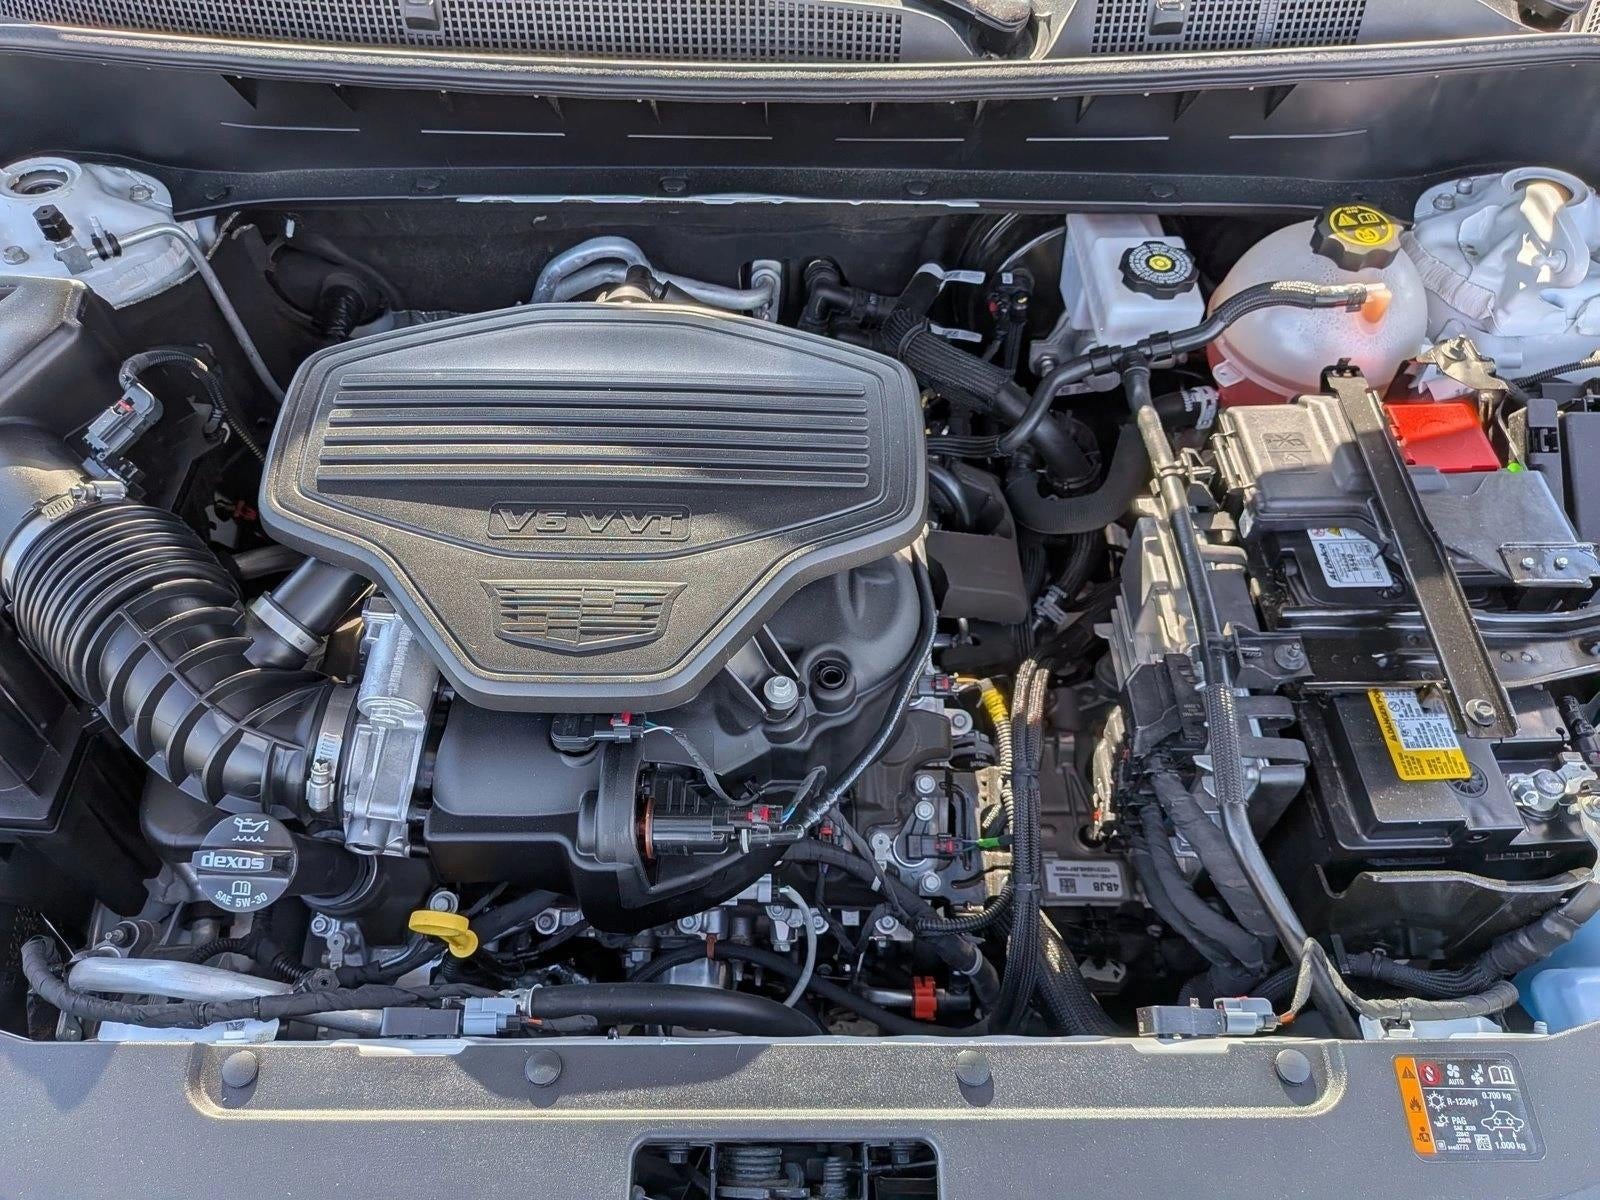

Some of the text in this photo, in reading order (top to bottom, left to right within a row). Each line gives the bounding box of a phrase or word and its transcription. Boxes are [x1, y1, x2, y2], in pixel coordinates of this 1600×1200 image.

[498, 508, 683, 535] V6 VVT
[201, 852, 265, 870] dexos
[215, 890, 268, 908] SAE 5W-30
[1448, 1078, 1465, 1086] AUTO
[1502, 1092, 1512, 1101] kg
[1451, 1116, 1467, 1125] PAG
[1516, 1142, 1527, 1151] kg
